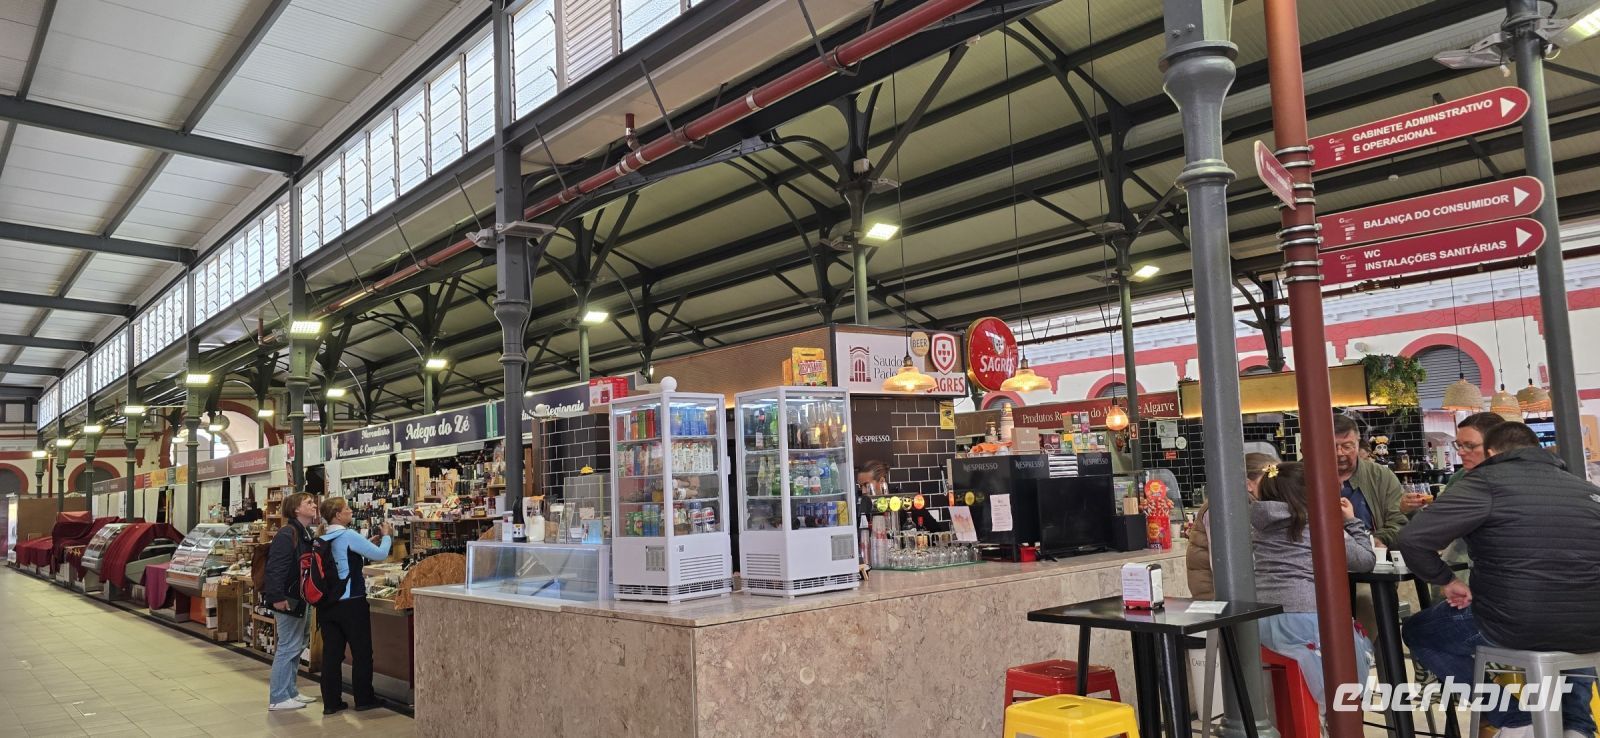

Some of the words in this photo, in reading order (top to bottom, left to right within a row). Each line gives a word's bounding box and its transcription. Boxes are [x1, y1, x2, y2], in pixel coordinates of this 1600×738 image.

[1352, 121, 1403, 142] GABINETE
[1405, 99, 1493, 129] ADMINSTRATIVO
[1353, 145, 1361, 154] E
[1363, 127, 1437, 152] OPERACIONAL
[1363, 212, 1413, 229] BALANÇA
[1414, 210, 1431, 220] DO
[1433, 194, 1509, 216] CONSUMIDOR
[1364, 249, 1381, 259] WC
[1364, 251, 1437, 271] INSTALAÇÕES
[1439, 240, 1507, 259] SANITÁRIAS
[912, 338, 928, 348] BEER
[979, 355, 1015, 375] SAGRES
[544, 399, 585, 416] Regionais
[1022, 413, 1054, 424] Produtos
[1091, 407, 1101, 418] do
[1143, 401, 1175, 416] Algarve
[405, 423, 436, 444] Adega
[438, 418, 452, 436] do
[453, 414, 470, 433] Zé
[855, 435, 890, 444] NESPRESSO
[963, 462, 998, 472] NESPRESSO
[1015, 460, 1044, 469] NESPRESSO
[1082, 457, 1109, 466] NESPRESSO
